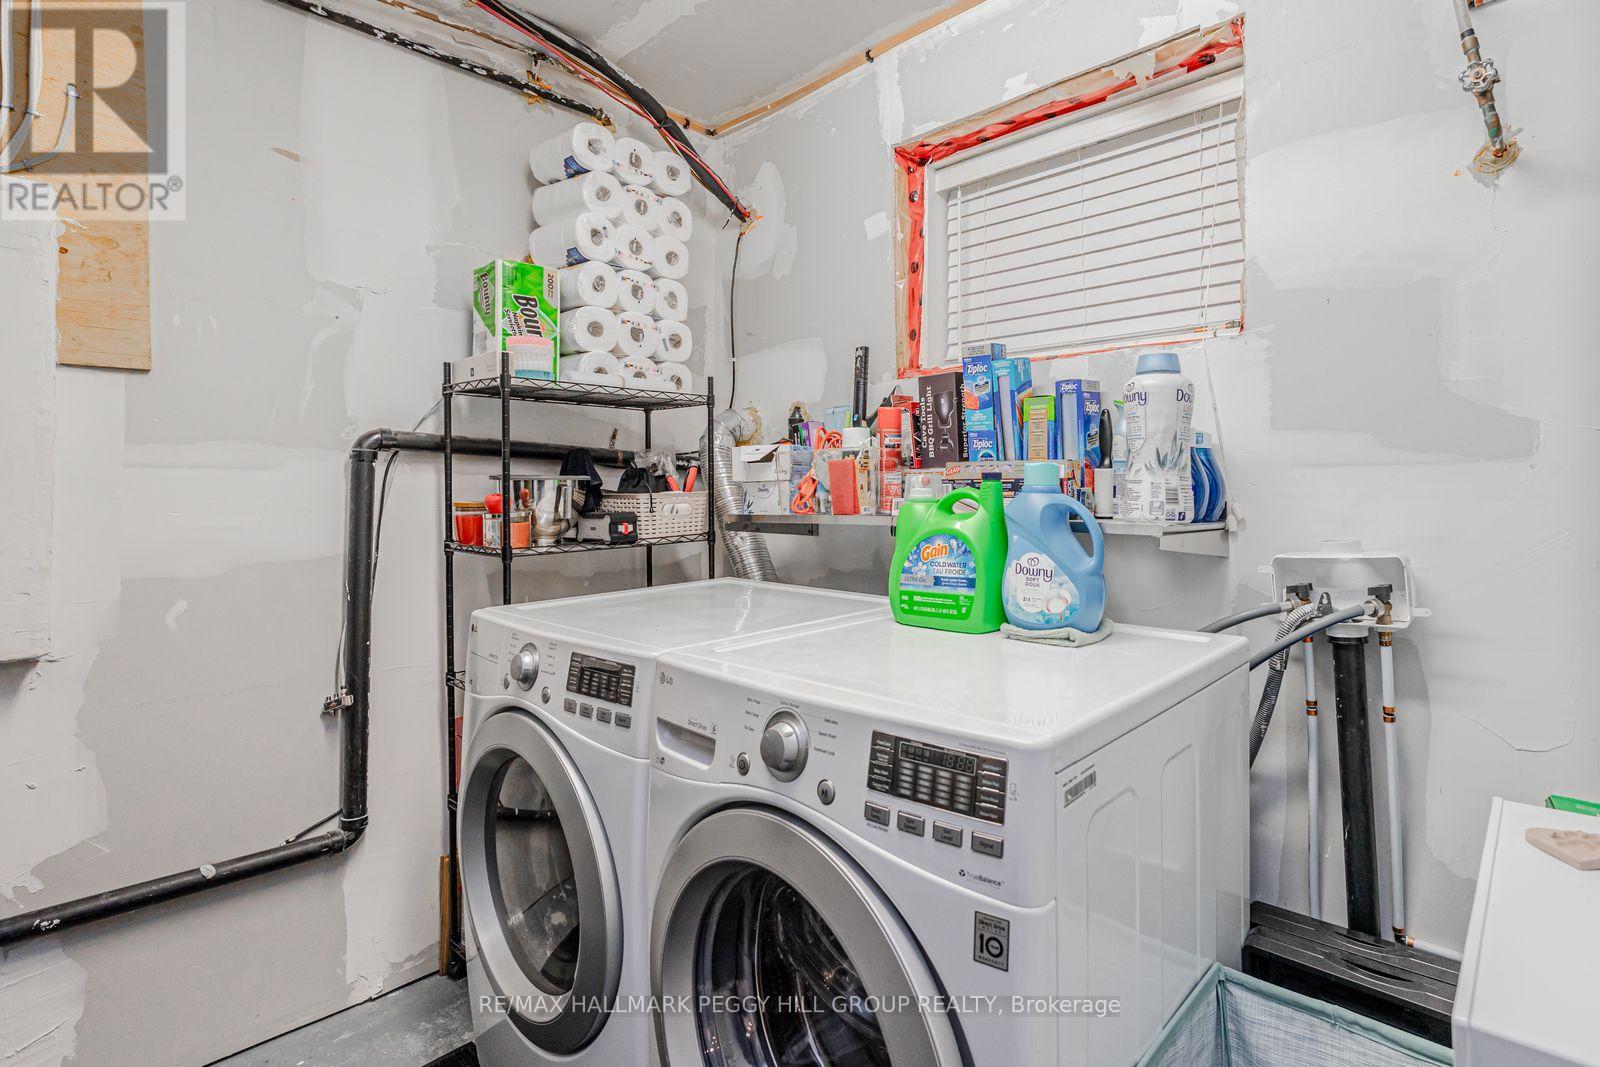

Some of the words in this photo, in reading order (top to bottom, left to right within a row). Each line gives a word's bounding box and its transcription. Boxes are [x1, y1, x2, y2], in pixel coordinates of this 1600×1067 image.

[967, 364, 988, 375] Ziploc
[1060, 382, 1078, 392] Ziploc
[1084, 400, 1099, 415] Ziploc
[973, 439, 993, 450] Ziploc
[921, 543, 949, 561] Gain
[1015, 562, 1053, 582] Downy
[979, 933, 1004, 958] 10
